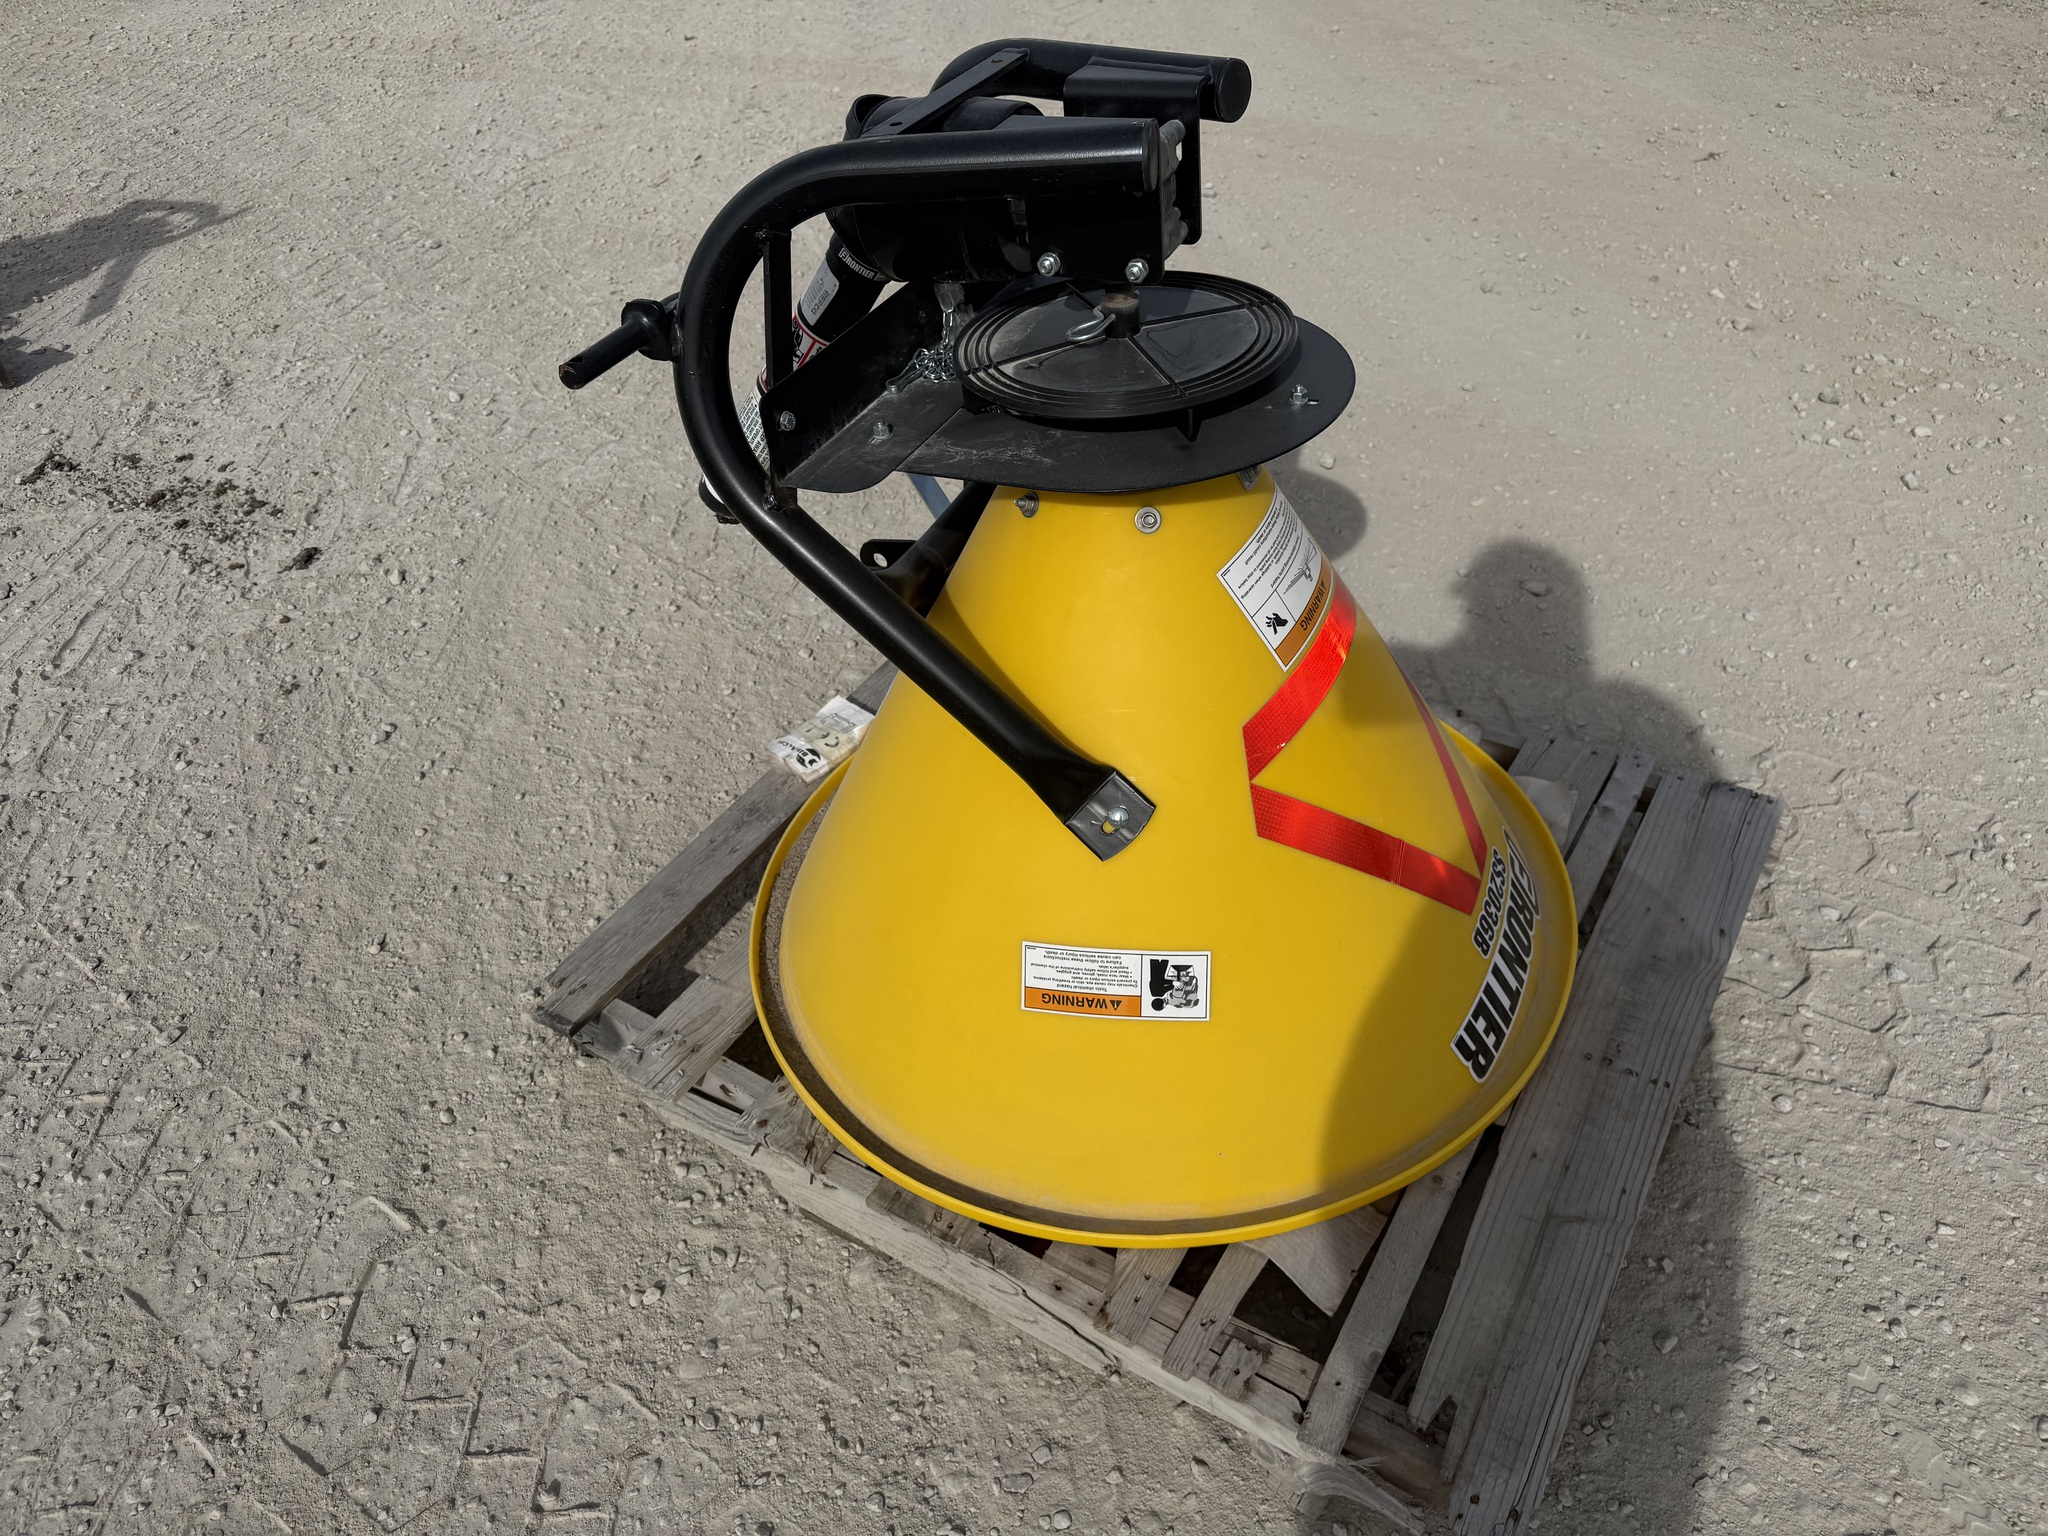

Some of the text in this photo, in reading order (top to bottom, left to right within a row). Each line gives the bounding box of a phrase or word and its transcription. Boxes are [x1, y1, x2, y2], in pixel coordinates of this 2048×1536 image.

[838, 247, 875, 280] FRONTIER
[1300, 588, 1325, 631] WARNING
[1474, 848, 1506, 955] SS2036B
[1453, 827, 1540, 1080] FRONTIER
[1041, 993, 1108, 1009] WARNING
